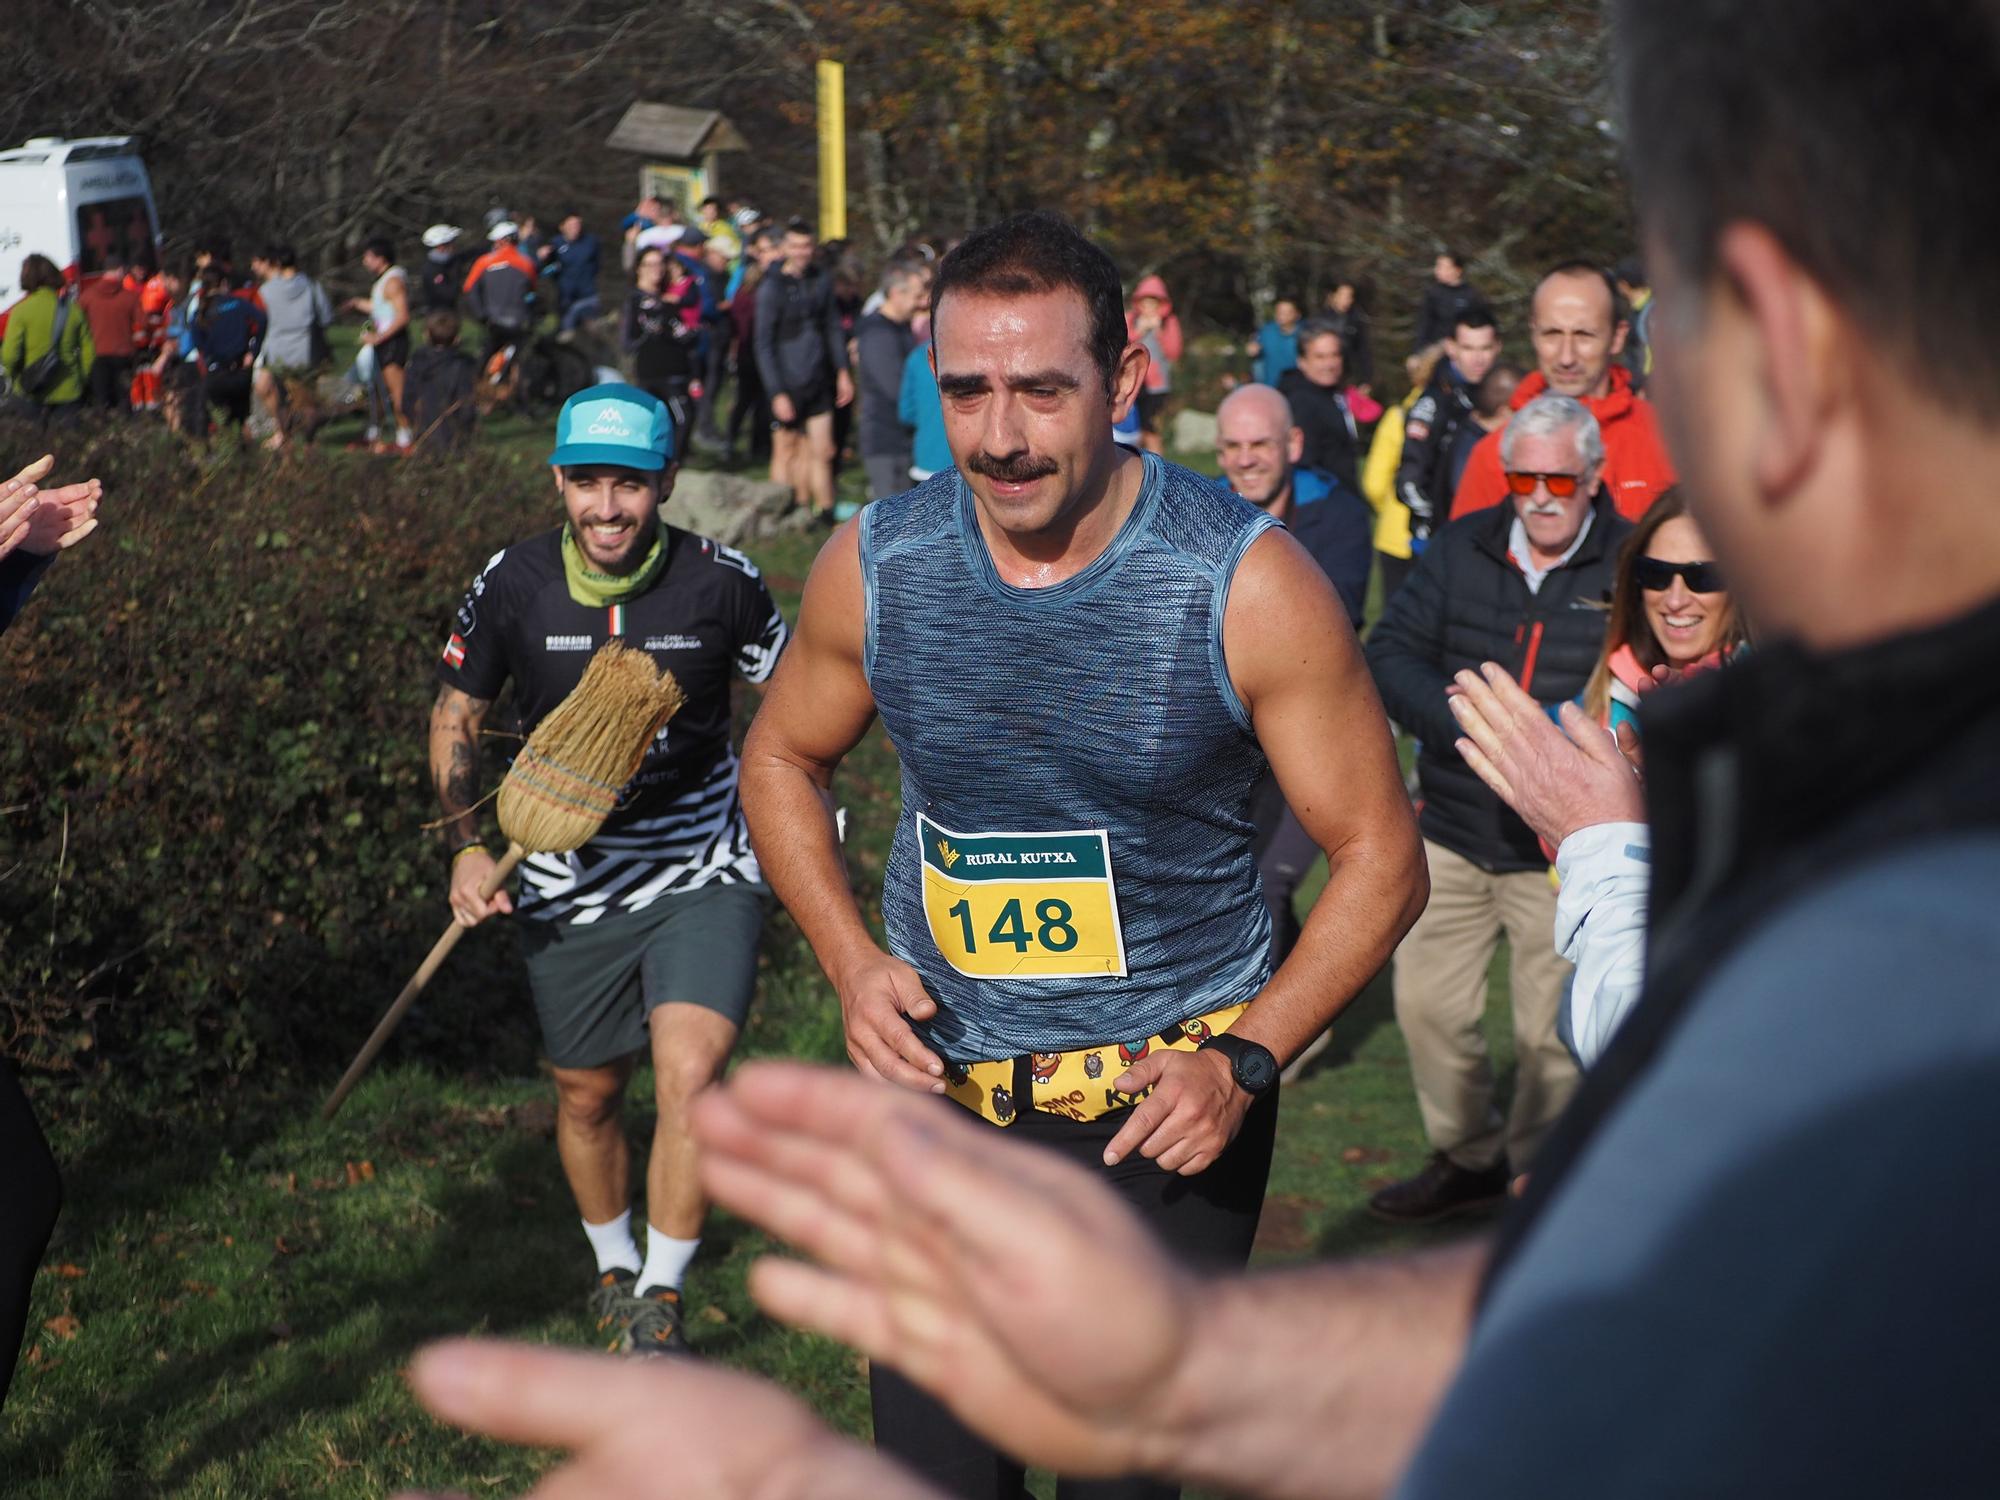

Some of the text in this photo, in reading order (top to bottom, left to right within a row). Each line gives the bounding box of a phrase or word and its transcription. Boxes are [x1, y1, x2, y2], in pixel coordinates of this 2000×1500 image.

[965, 852, 1077, 866] RURAL KUTXA
[949, 898, 1079, 954] 148
